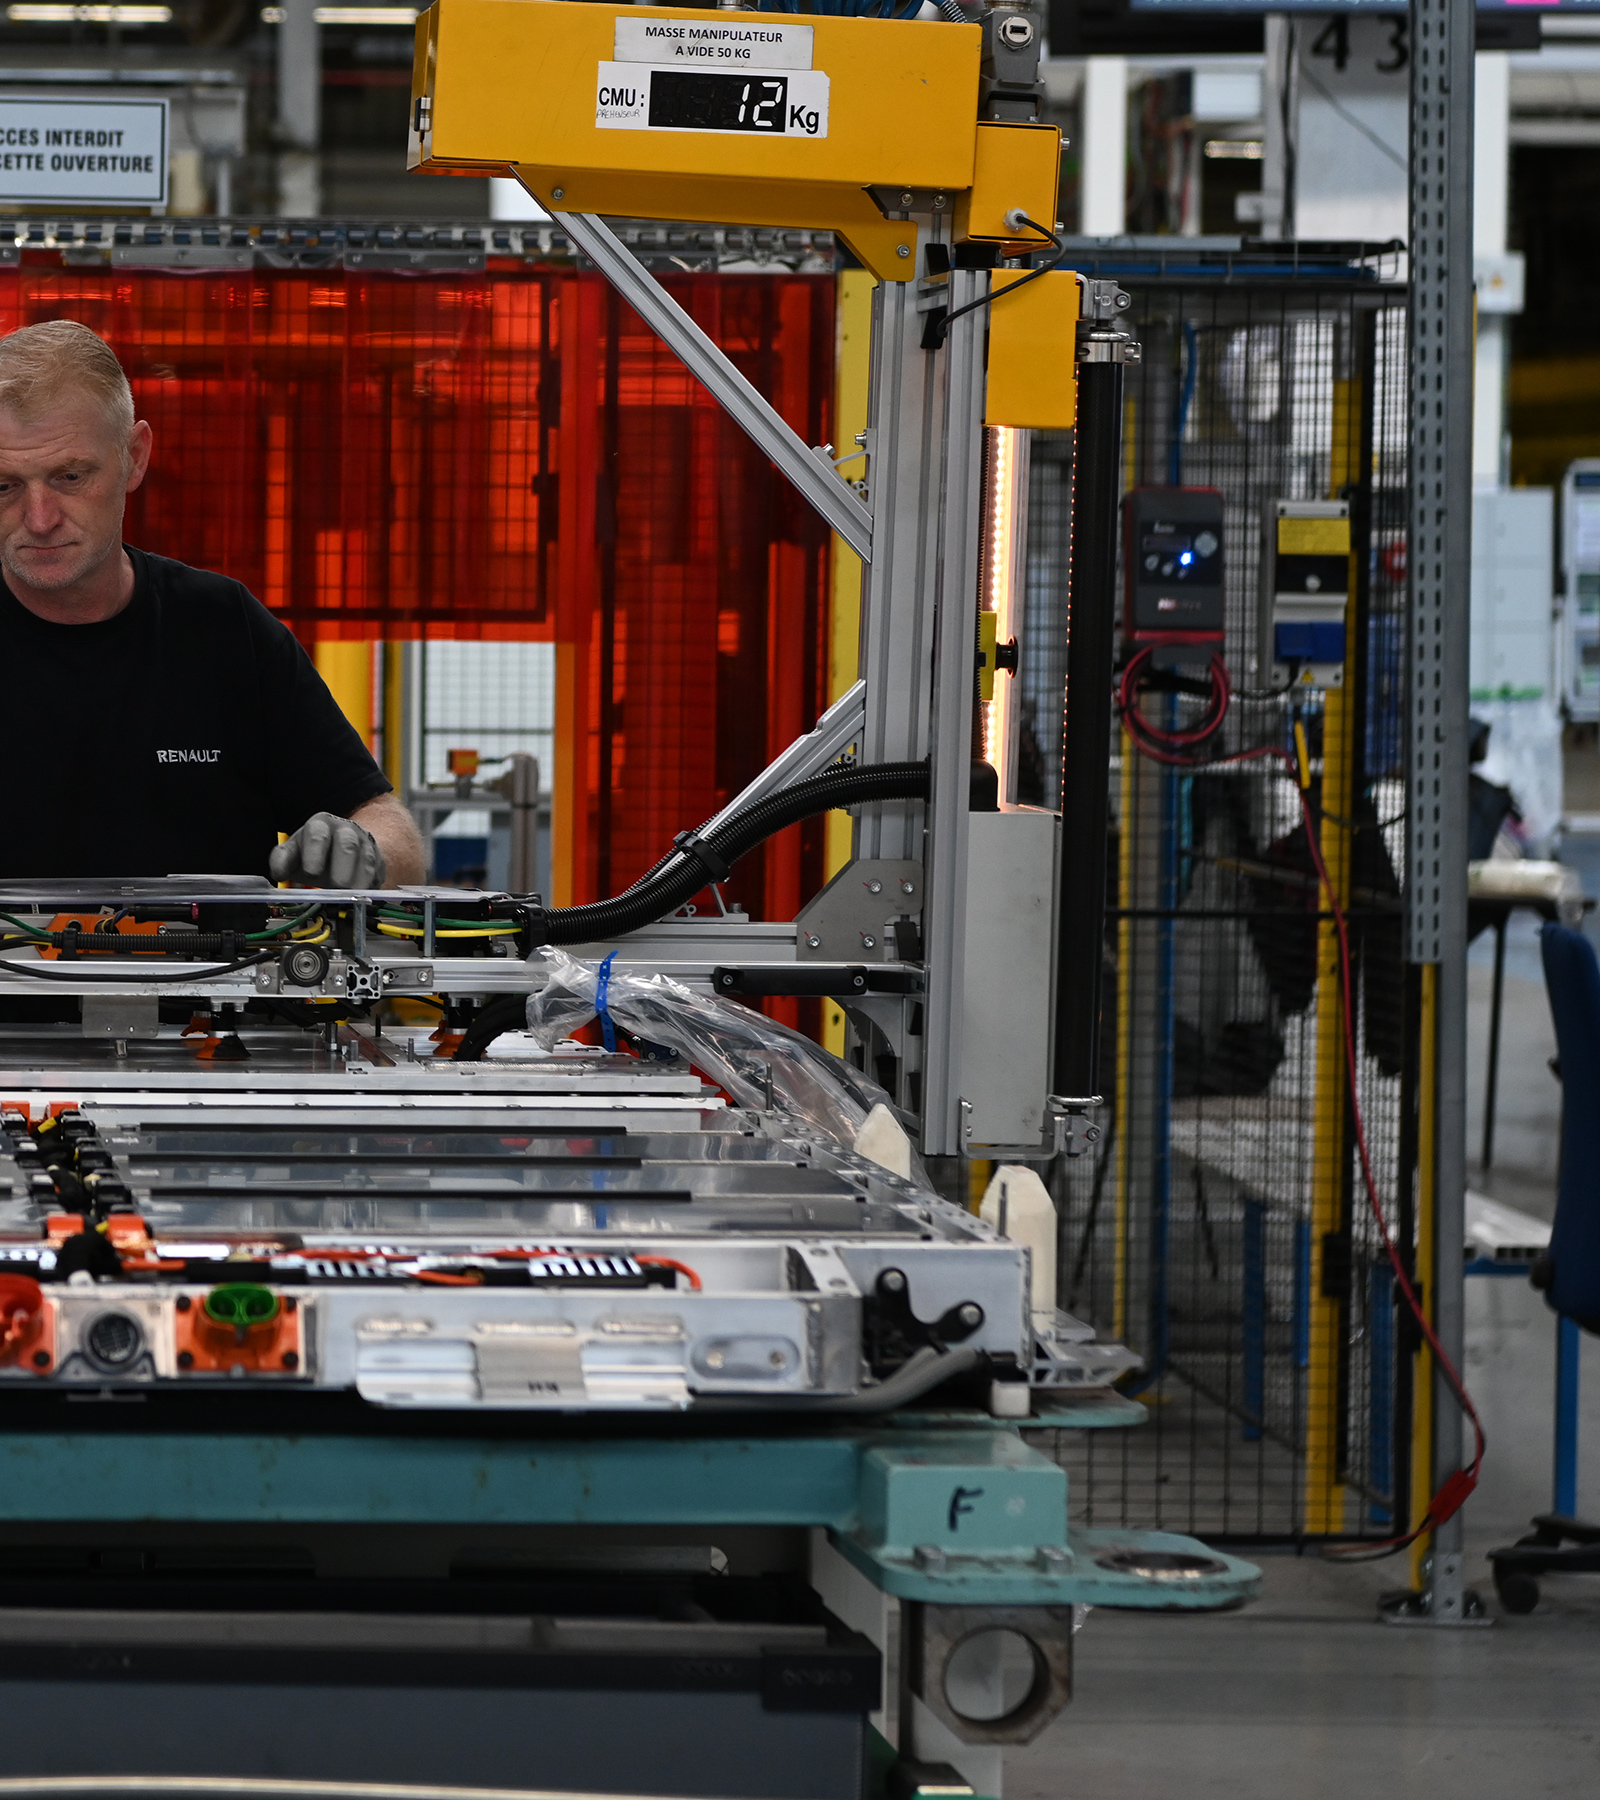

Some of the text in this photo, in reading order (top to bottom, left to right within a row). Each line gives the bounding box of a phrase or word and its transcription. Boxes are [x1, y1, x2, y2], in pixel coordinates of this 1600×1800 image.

[645, 26, 783, 43] MASSE MANIPULATEUR
[675, 45, 751, 59] A VIDE 50 KG
[738, 81, 784, 127] 12
[789, 104, 820, 134] Kg
[45, 130, 124, 148] INTERDIT
[51, 155, 153, 173] OUVERTURE
[156, 749, 221, 763] RENAULT
[949, 1486, 984, 1532] F
